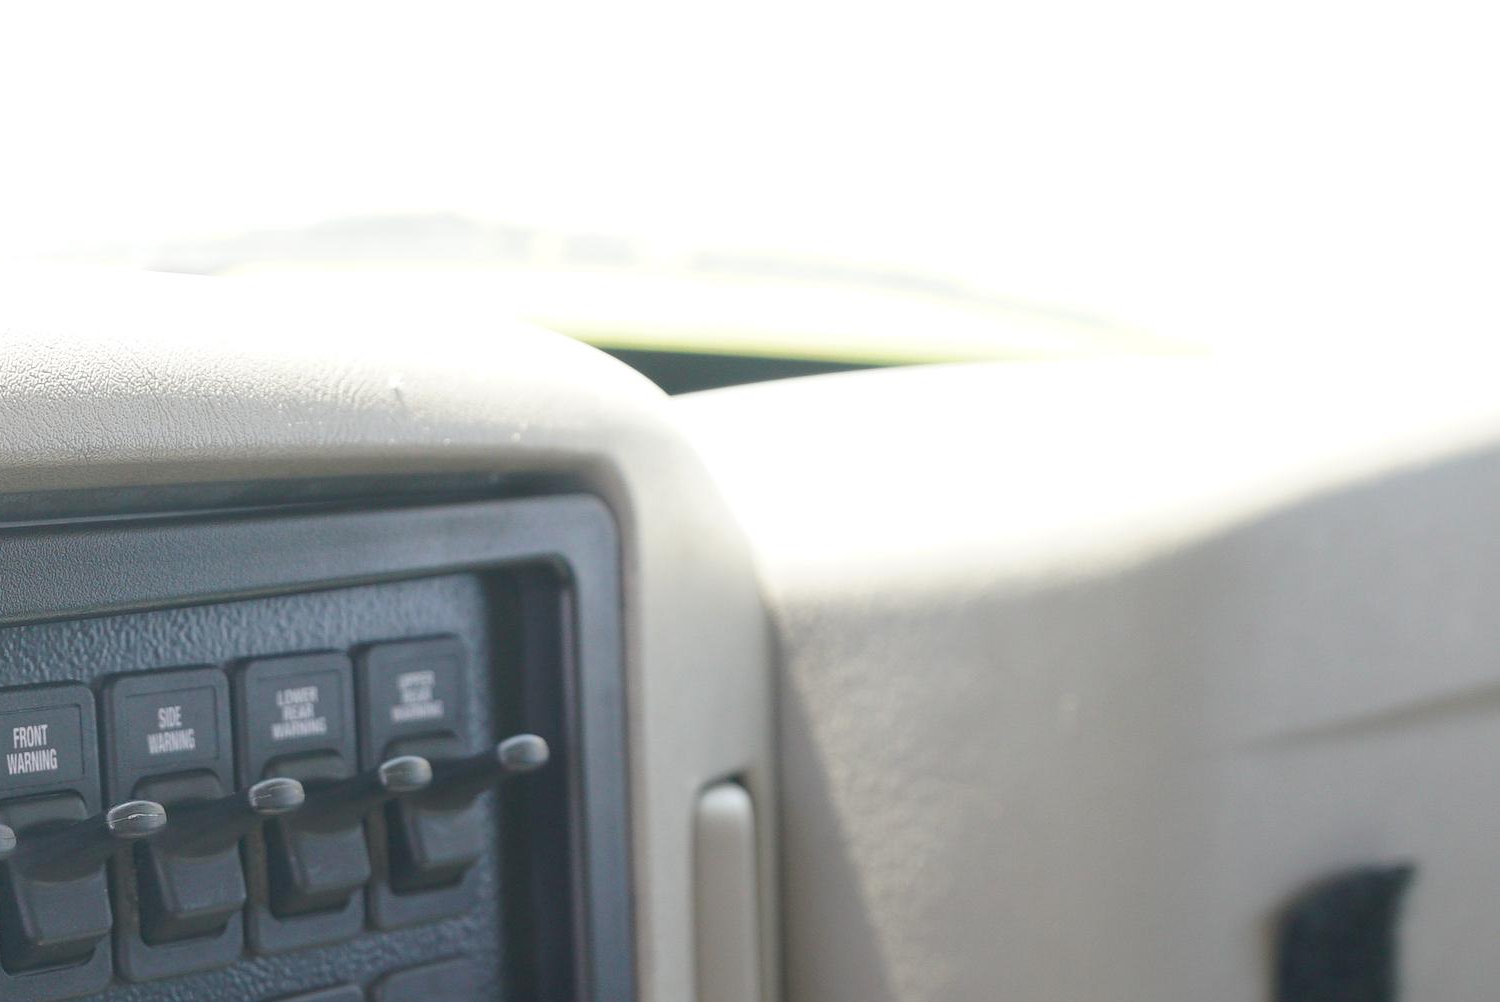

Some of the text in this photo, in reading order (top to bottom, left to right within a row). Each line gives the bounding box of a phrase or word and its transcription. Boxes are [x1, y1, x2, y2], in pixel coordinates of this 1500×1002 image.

[276, 686, 319, 707] LOWER
[158, 706, 183, 729] SIDE
[282, 703, 315, 721] REAR
[390, 700, 445, 722] WARNING
[12, 724, 49, 749] FRONT
[271, 717, 328, 740] WARNING
[148, 728, 197, 754] WARNING
[6, 748, 59, 776] WARNING
